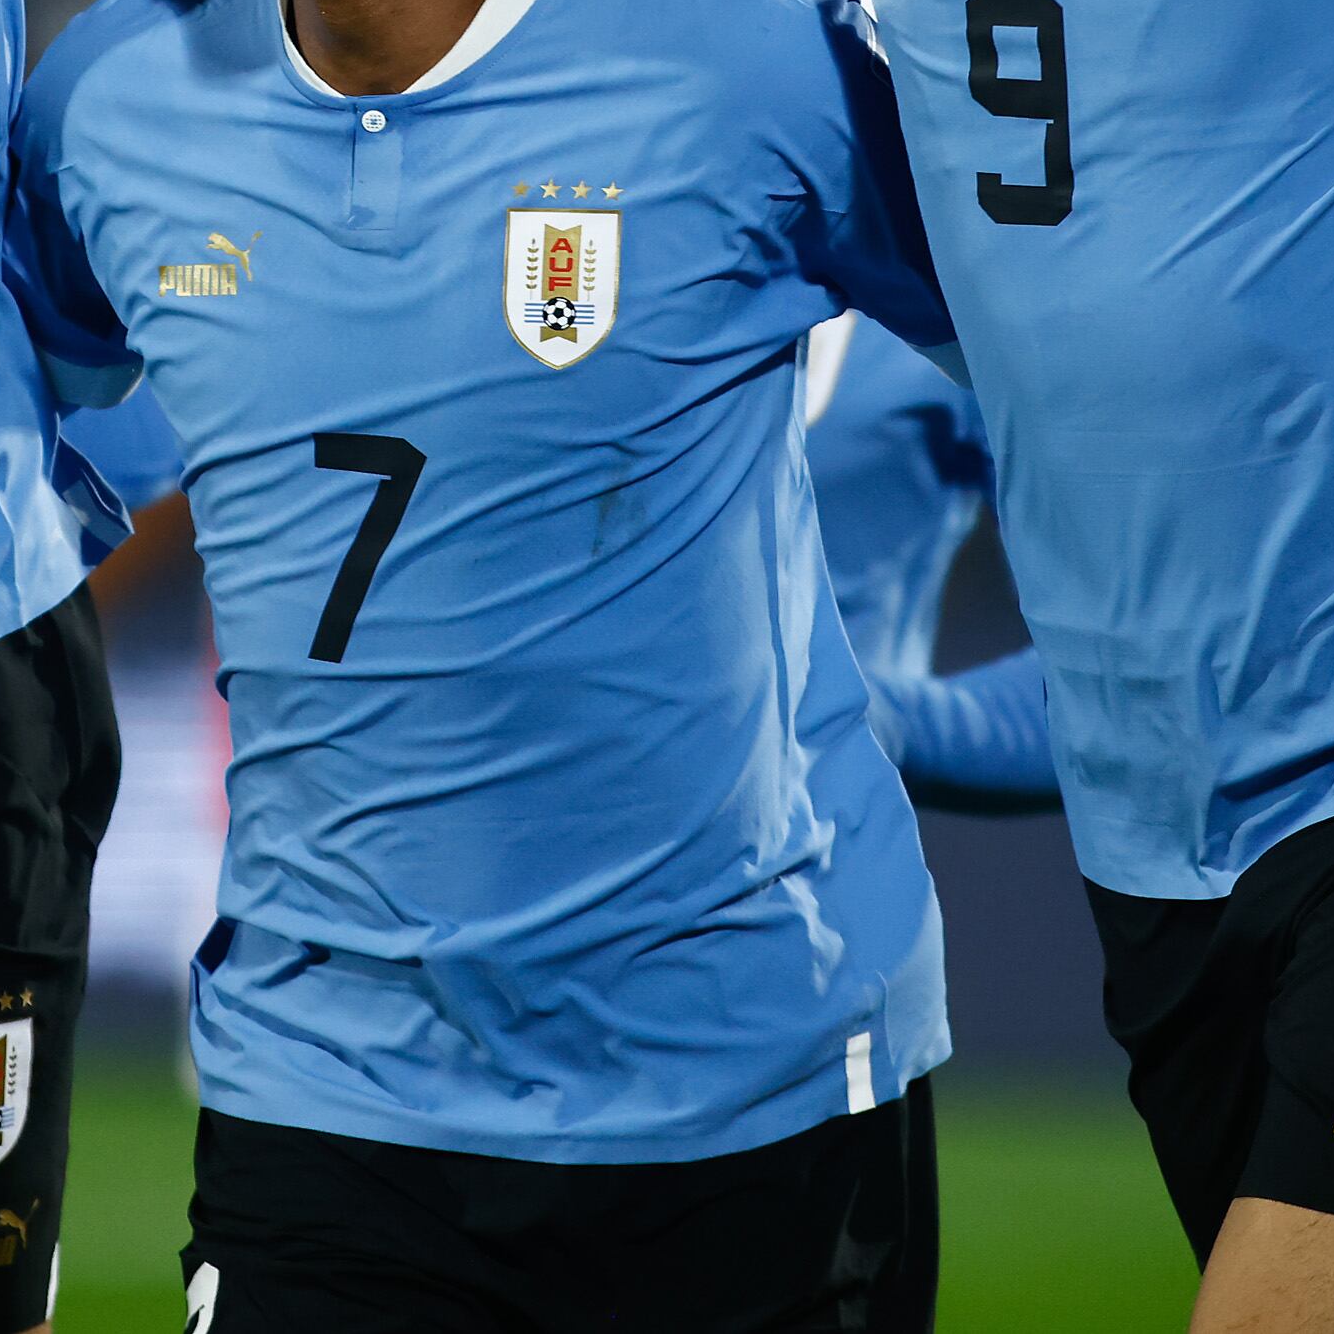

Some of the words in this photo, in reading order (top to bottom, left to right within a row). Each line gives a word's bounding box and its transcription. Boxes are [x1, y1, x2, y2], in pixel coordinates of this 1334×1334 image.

[159, 263, 238, 297] PUMA
[548, 237, 574, 293] AUF
[308, 431, 427, 664] 7
